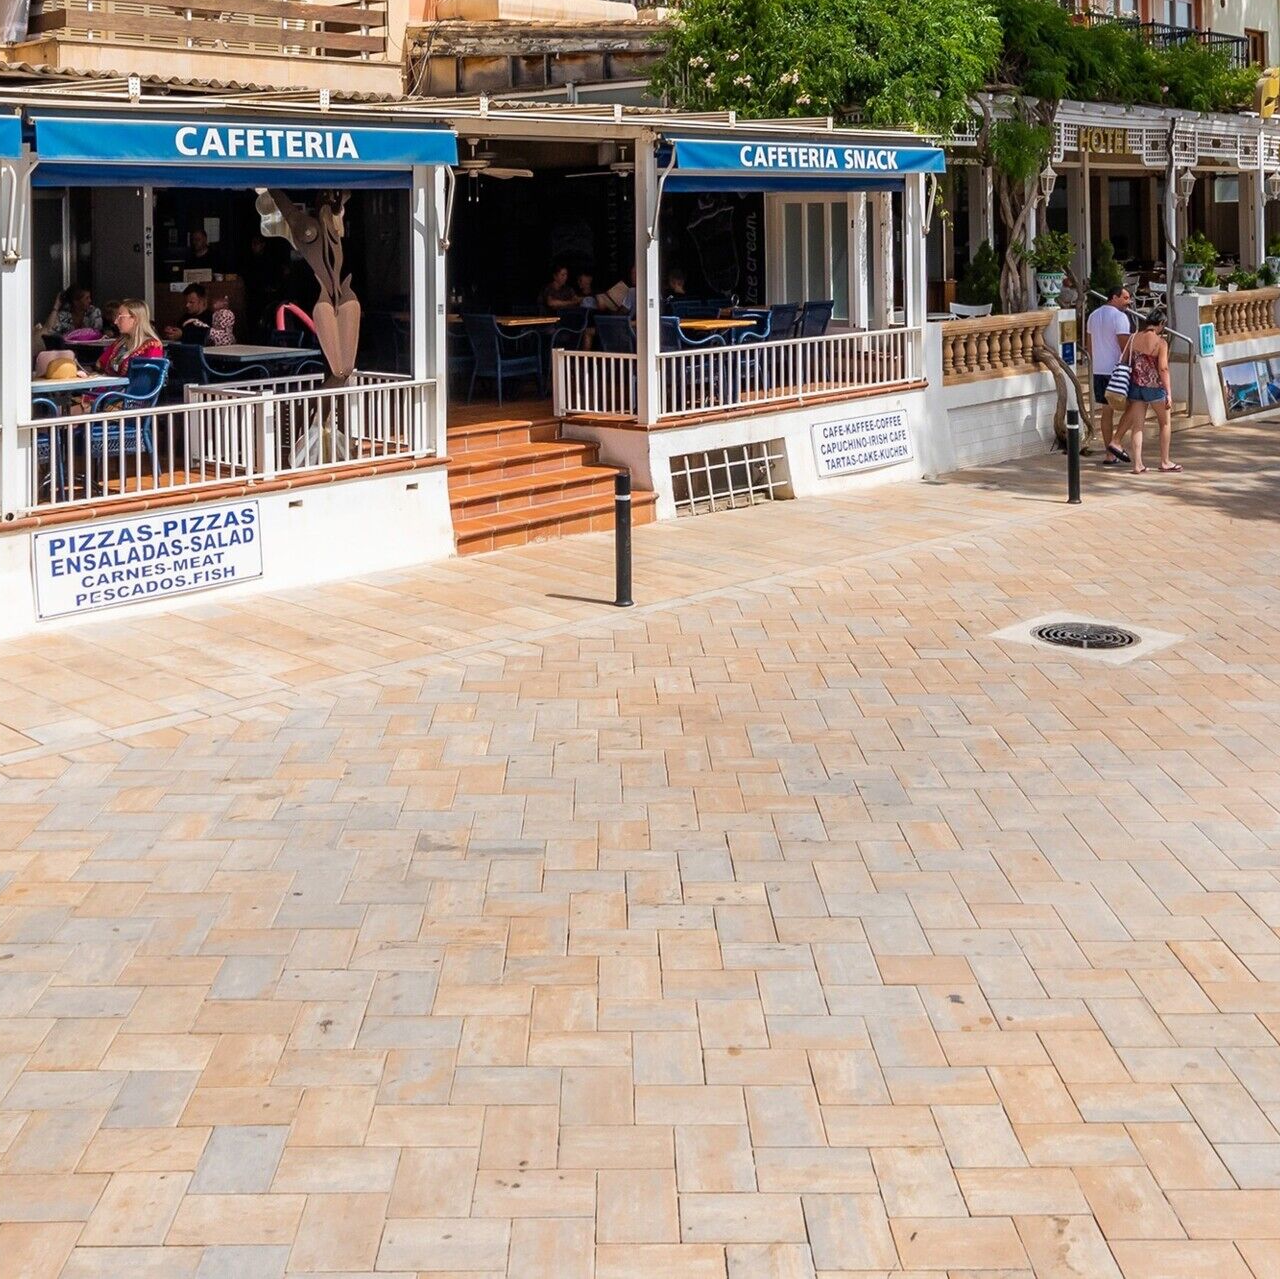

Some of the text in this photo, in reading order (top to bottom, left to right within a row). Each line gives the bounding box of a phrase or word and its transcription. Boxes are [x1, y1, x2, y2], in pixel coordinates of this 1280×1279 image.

[175, 126, 359, 159] CAFETERIA
[1078, 126, 1133, 154] HOTEL
[740, 145, 898, 170] CAFETERIA SNACK
[745, 211, 757, 273] cream
[820, 429, 907, 455] CAPUCHINO-IRISH CAFE
[822, 415, 902, 439] CAFE-KAFFEE-COFFEE
[825, 445, 908, 470] TARTAS-CAKE-KUCHEN
[49, 508, 255, 557] PIZZAS-PIZZAS
[51, 527, 254, 577] ENSALADAS-SALAD
[75, 566, 235, 606] PESCADOS.FISH
[81, 552, 225, 588] CARNES-MEAT
